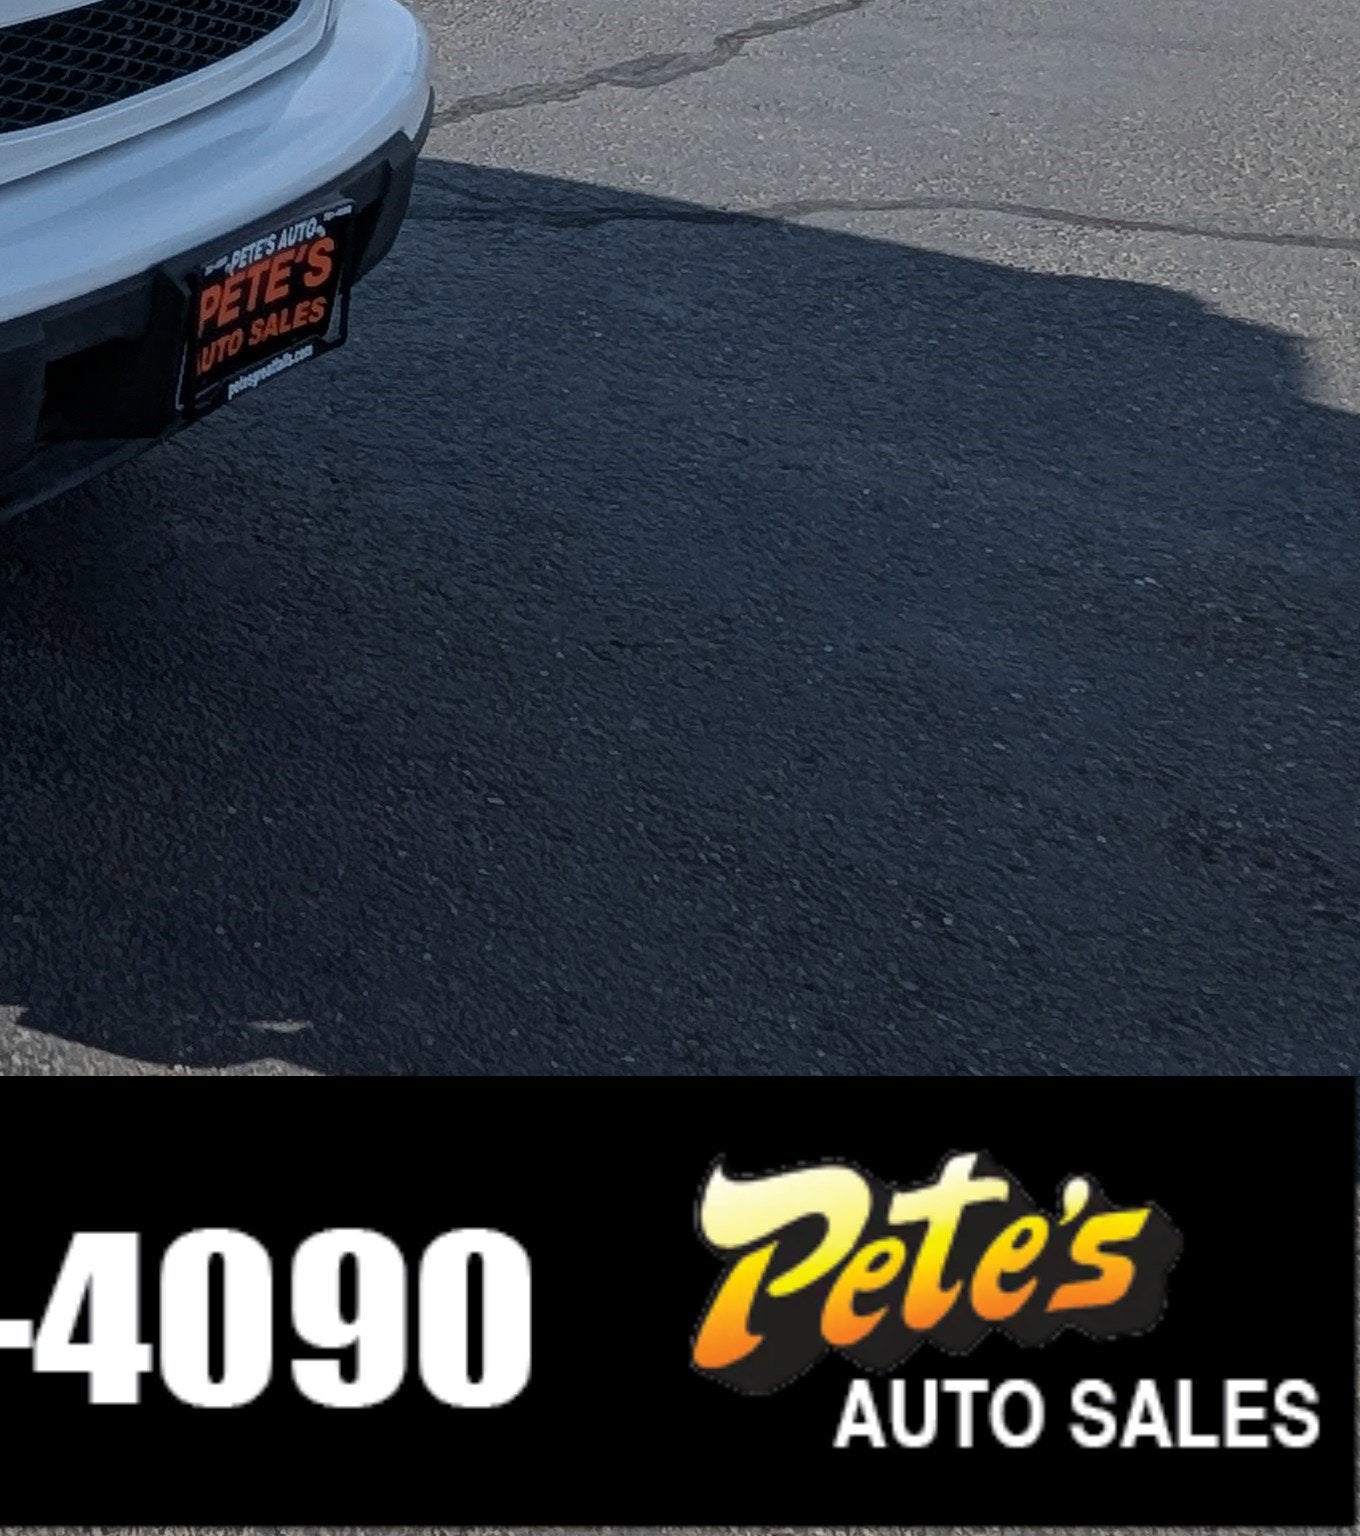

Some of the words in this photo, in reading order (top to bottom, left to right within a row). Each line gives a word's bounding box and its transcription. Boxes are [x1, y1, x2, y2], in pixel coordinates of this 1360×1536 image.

[279, 217, 318, 248] AUTO
[198, 237, 335, 338] PETE'S
[248, 297, 327, 346] SALES
